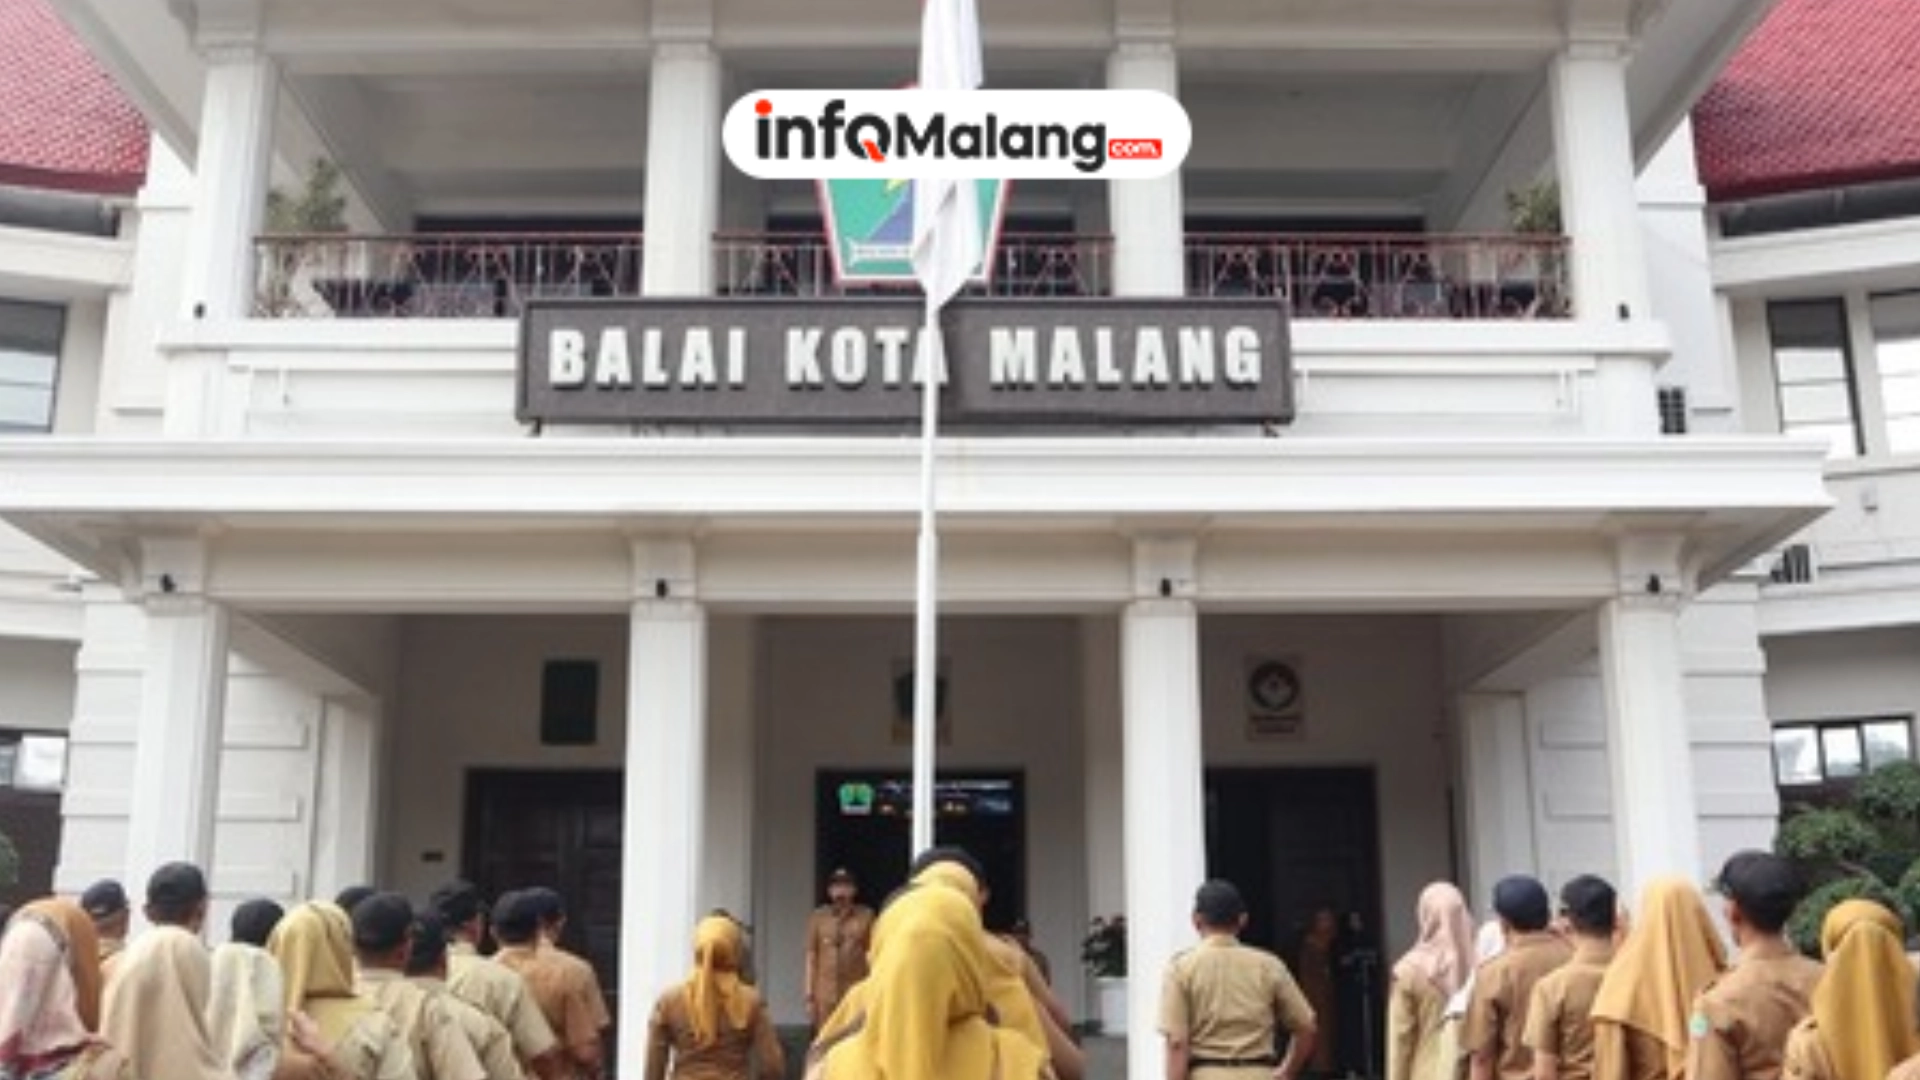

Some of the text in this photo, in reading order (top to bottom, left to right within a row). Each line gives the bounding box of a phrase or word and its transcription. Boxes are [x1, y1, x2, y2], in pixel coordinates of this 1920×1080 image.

[548, 325, 1263, 388] BALAI KOTA MALANG
